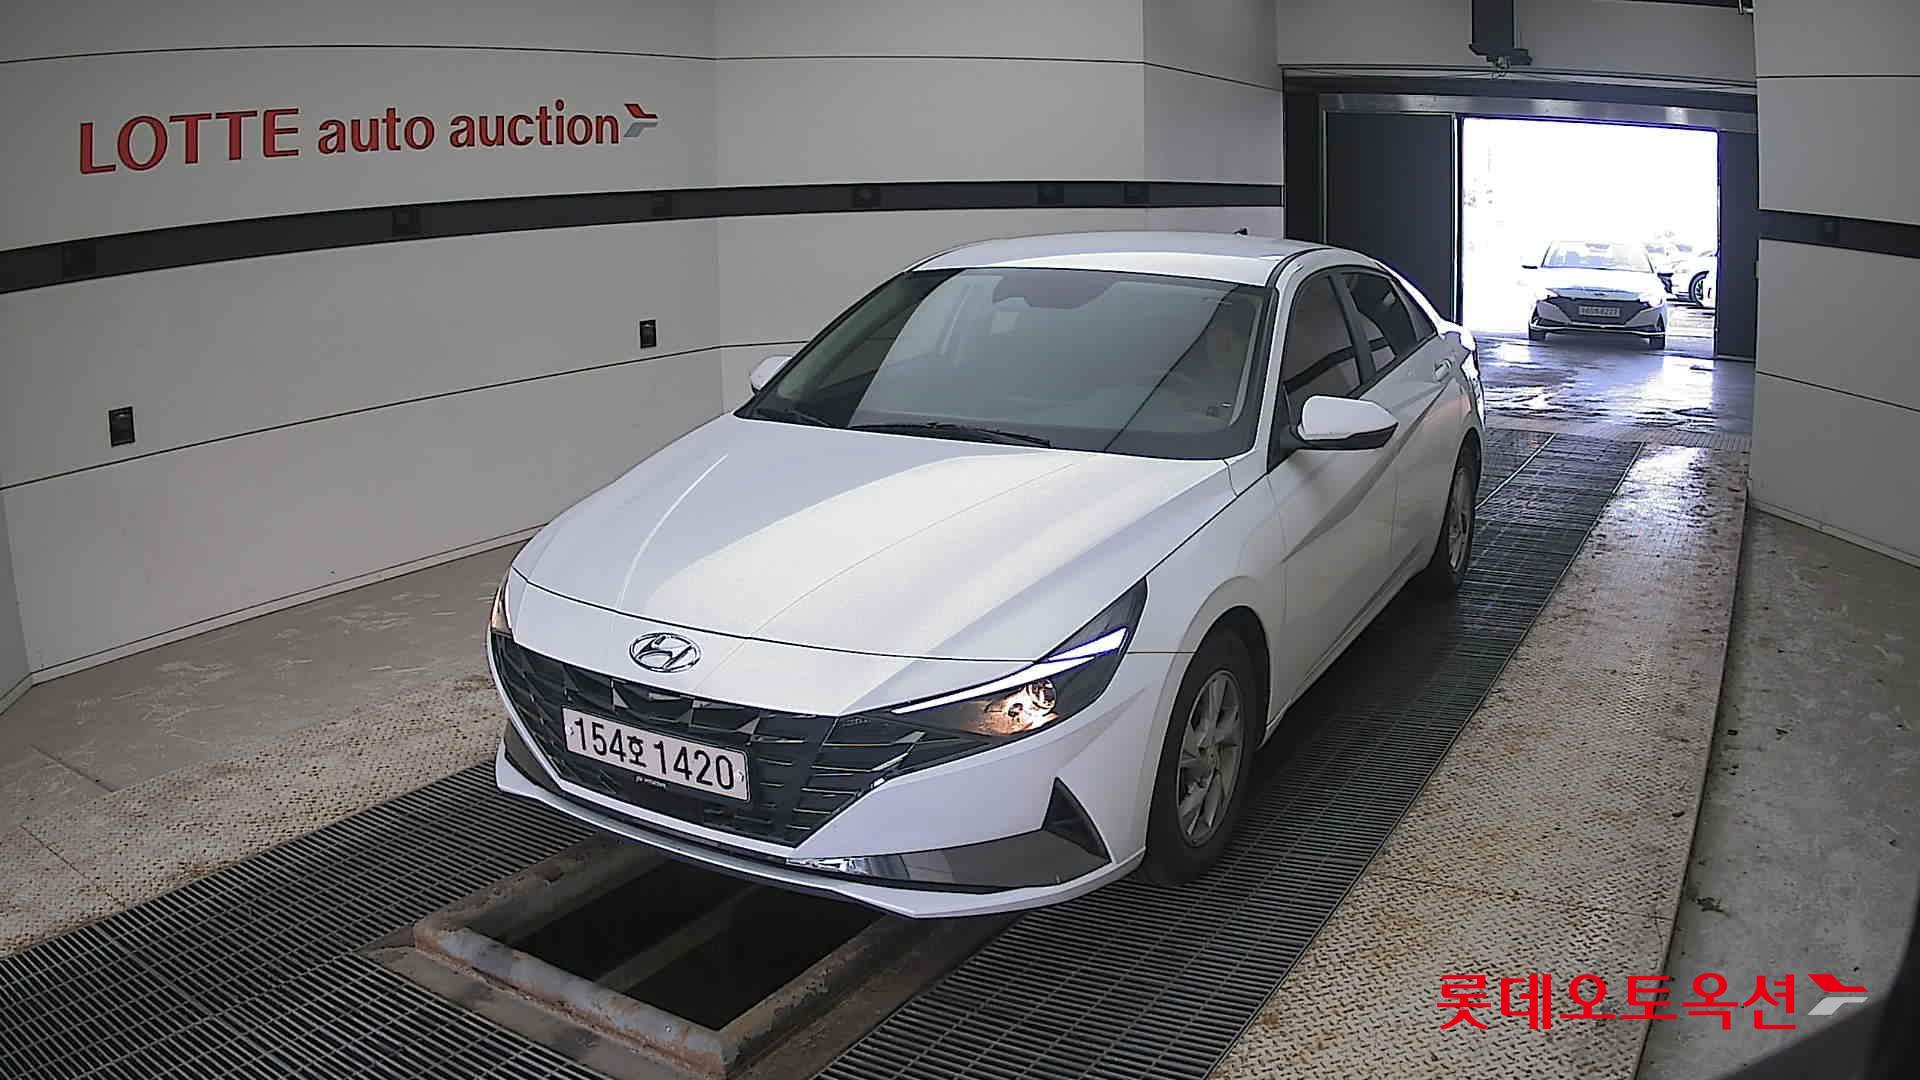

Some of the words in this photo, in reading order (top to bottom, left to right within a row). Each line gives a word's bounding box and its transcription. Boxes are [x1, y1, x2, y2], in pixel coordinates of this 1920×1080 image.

[79, 108, 299, 175] LOTTE
[317, 106, 436, 155] auto
[449, 99, 620, 147] auction
[574, 717, 647, 768] 154호
[653, 740, 735, 790] 1420
